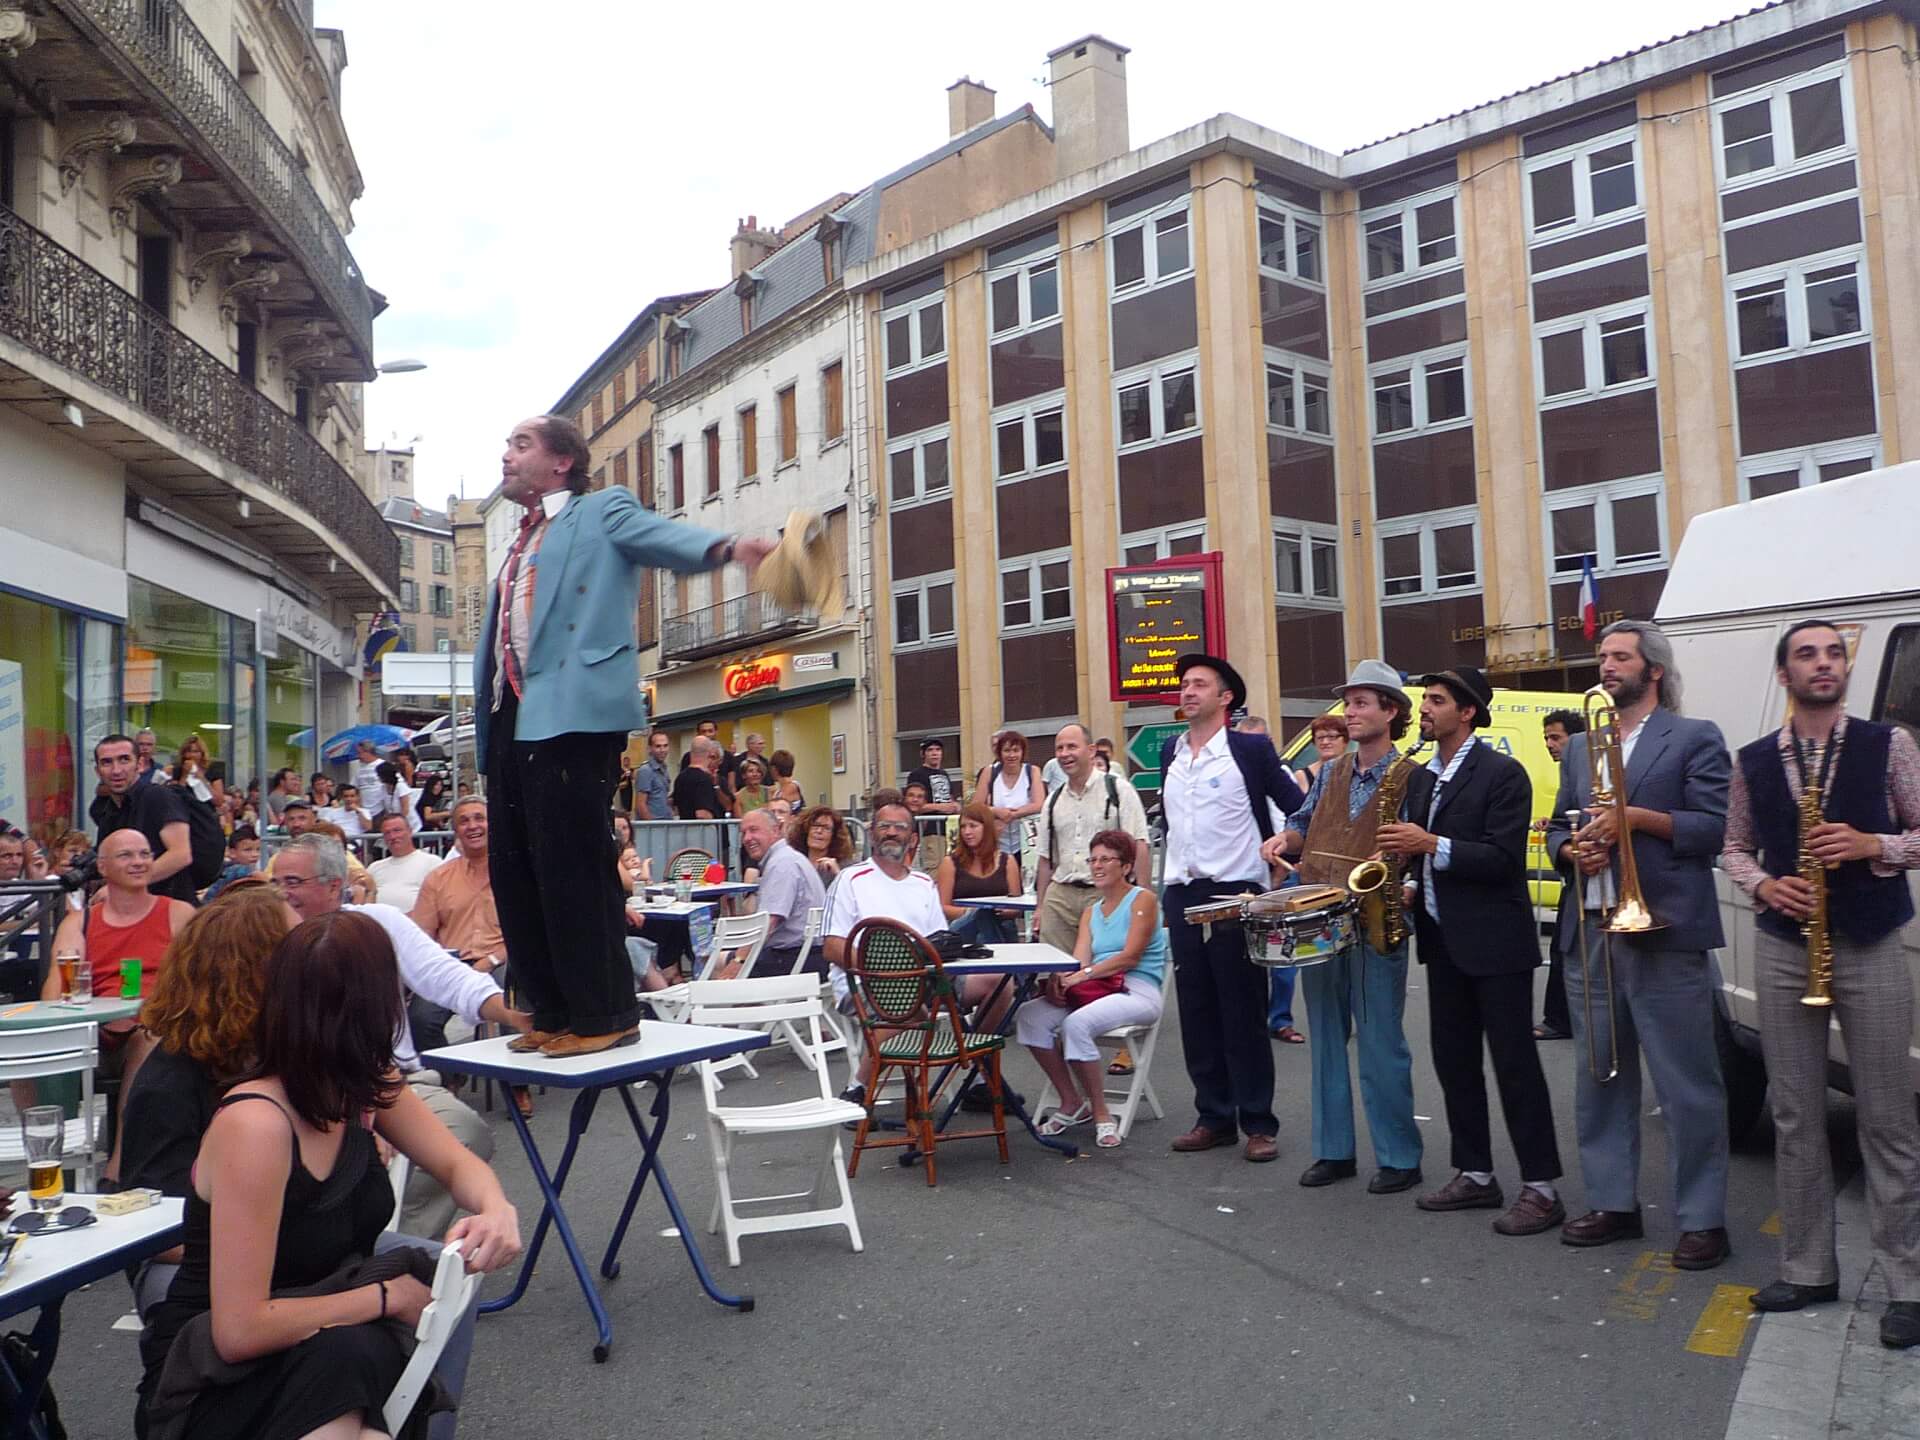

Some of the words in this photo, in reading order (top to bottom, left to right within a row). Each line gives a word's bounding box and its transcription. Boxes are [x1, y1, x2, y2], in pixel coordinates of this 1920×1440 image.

[1558, 609, 1625, 631] EGITE
[795, 656, 833, 668] Casino
[725, 664, 781, 697] Casino
[1511, 704, 1529, 713] DE
